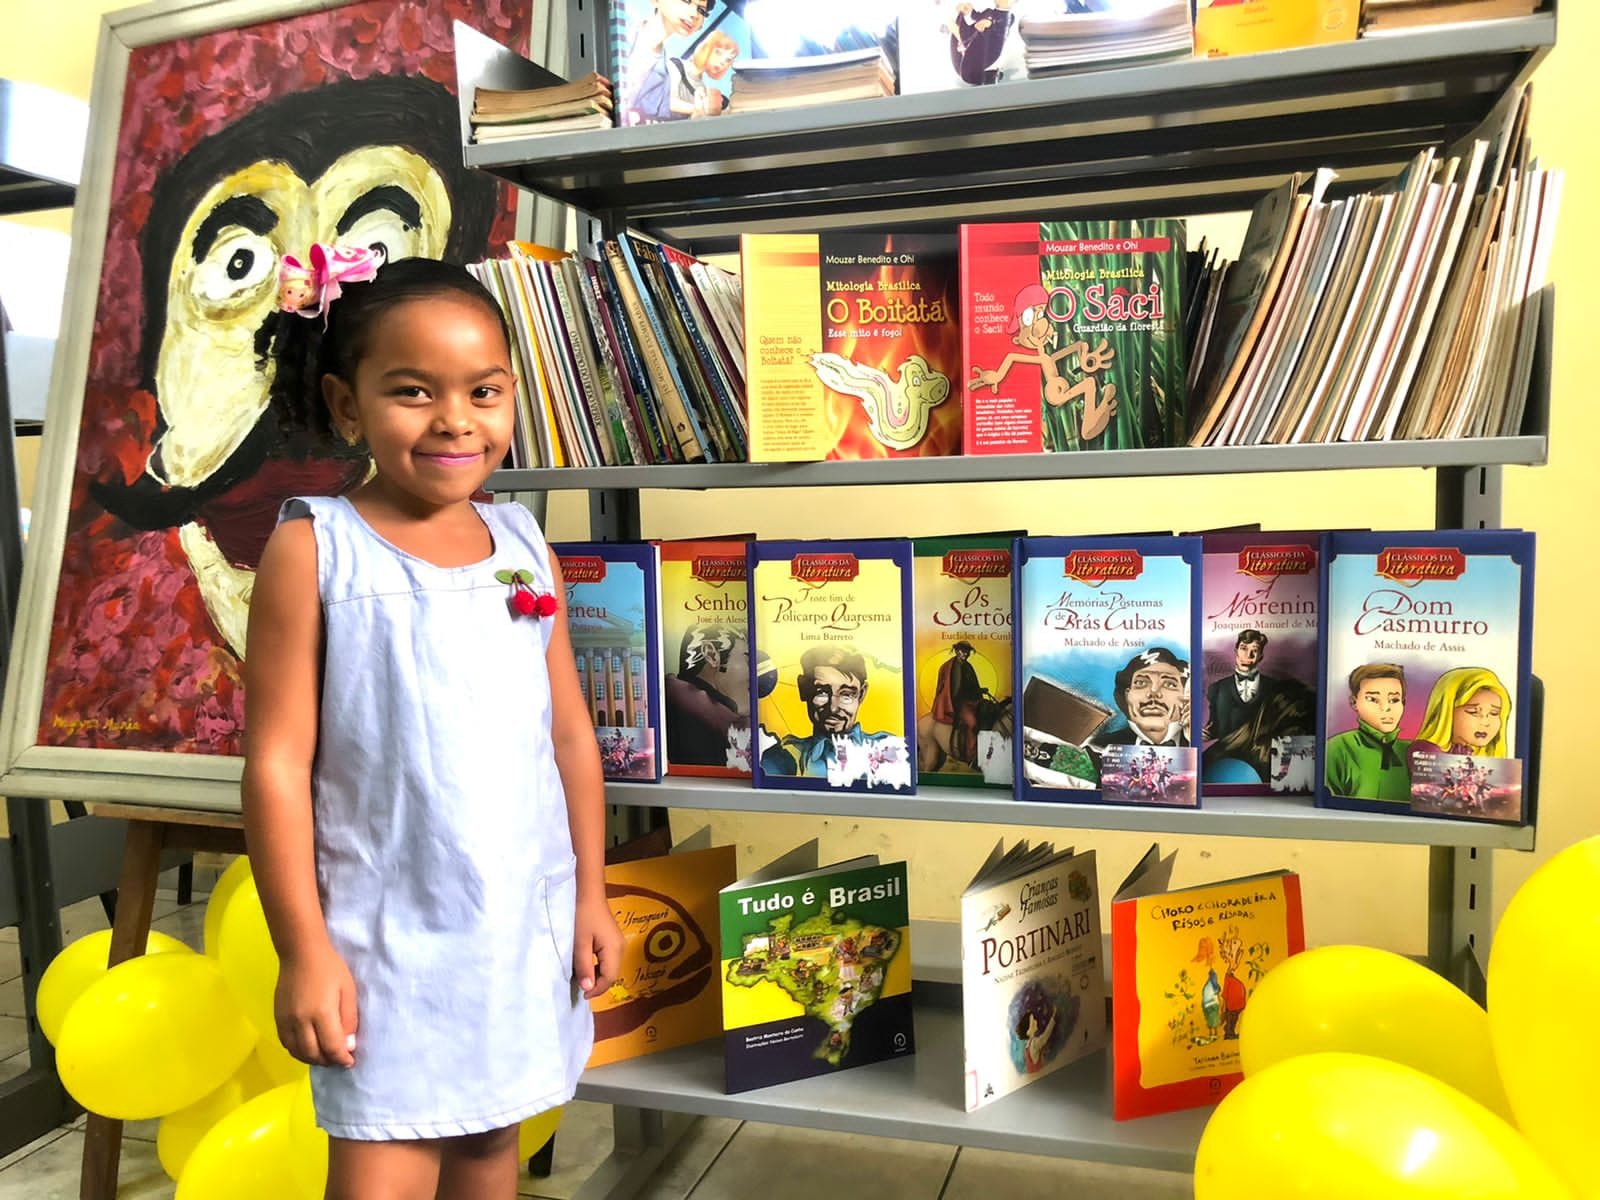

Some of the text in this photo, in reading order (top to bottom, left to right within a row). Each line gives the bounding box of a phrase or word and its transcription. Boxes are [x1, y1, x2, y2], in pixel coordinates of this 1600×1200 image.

[1046, 244, 1077, 253] Mouzar
[1079, 242, 1114, 252] Benedito
[826, 255, 856, 264] Mouzar
[857, 254, 892, 264] Benedito
[1046, 268, 1095, 281] Mitologia
[826, 281, 874, 293] Mitologia
[974, 292, 995, 302] Todo
[1046, 283, 1164, 322] O Saci
[827, 297, 945, 324] O Boitatá
[975, 303, 1005, 313] mundo
[975, 313, 1009, 323] conhece
[828, 328, 848, 338] Esse
[850, 328, 871, 337] mito
[974, 326, 980, 334] o
[1073, 322, 1114, 333] Guardião
[1115, 322, 1127, 332] da
[760, 335, 801, 345] Quem não
[760, 346, 793, 355] conhece
[1077, 555, 1133, 563] CLÁSSICOS DA
[1391, 553, 1438, 562] CLÁSSICOS
[791, 558, 852, 584] Literatura
[943, 553, 1006, 580] Literatura
[1065, 555, 1135, 583] Literatura
[1237, 551, 1306, 578] Literatura
[1377, 552, 1456, 582] Literatura
[684, 592, 747, 612] Senho
[829, 593, 843, 603] fim
[845, 593, 855, 602] de
[965, 586, 989, 609] Os
[1362, 589, 1453, 616] Dom
[568, 606, 608, 618] eneu
[1207, 592, 1315, 620] Morenin
[714, 615, 723, 624] de
[762, 595, 892, 631] Policarpo Quaresma
[933, 600, 1012, 627] Sertõe
[1045, 606, 1166, 631] de Brás Cubas
[1212, 620, 1252, 632] Joaquim
[1254, 619, 1289, 629] Manuel
[1292, 619, 1302, 628] de
[1354, 606, 1489, 636] Casmurro
[800, 632, 854, 641] Lima Barreto
[942, 631, 975, 640] Euclides
[977, 631, 988, 640] da
[1064, 637, 1145, 648] Machado de Assis
[1374, 639, 1466, 653] Machado de Assis
[737, 876, 901, 916] Tudo é Brasil
[1020, 876, 1059, 906] Crianças
[1018, 894, 1059, 924] Famosas
[1151, 904, 1195, 920] CHORO
[981, 909, 1092, 976] PORTINARI
